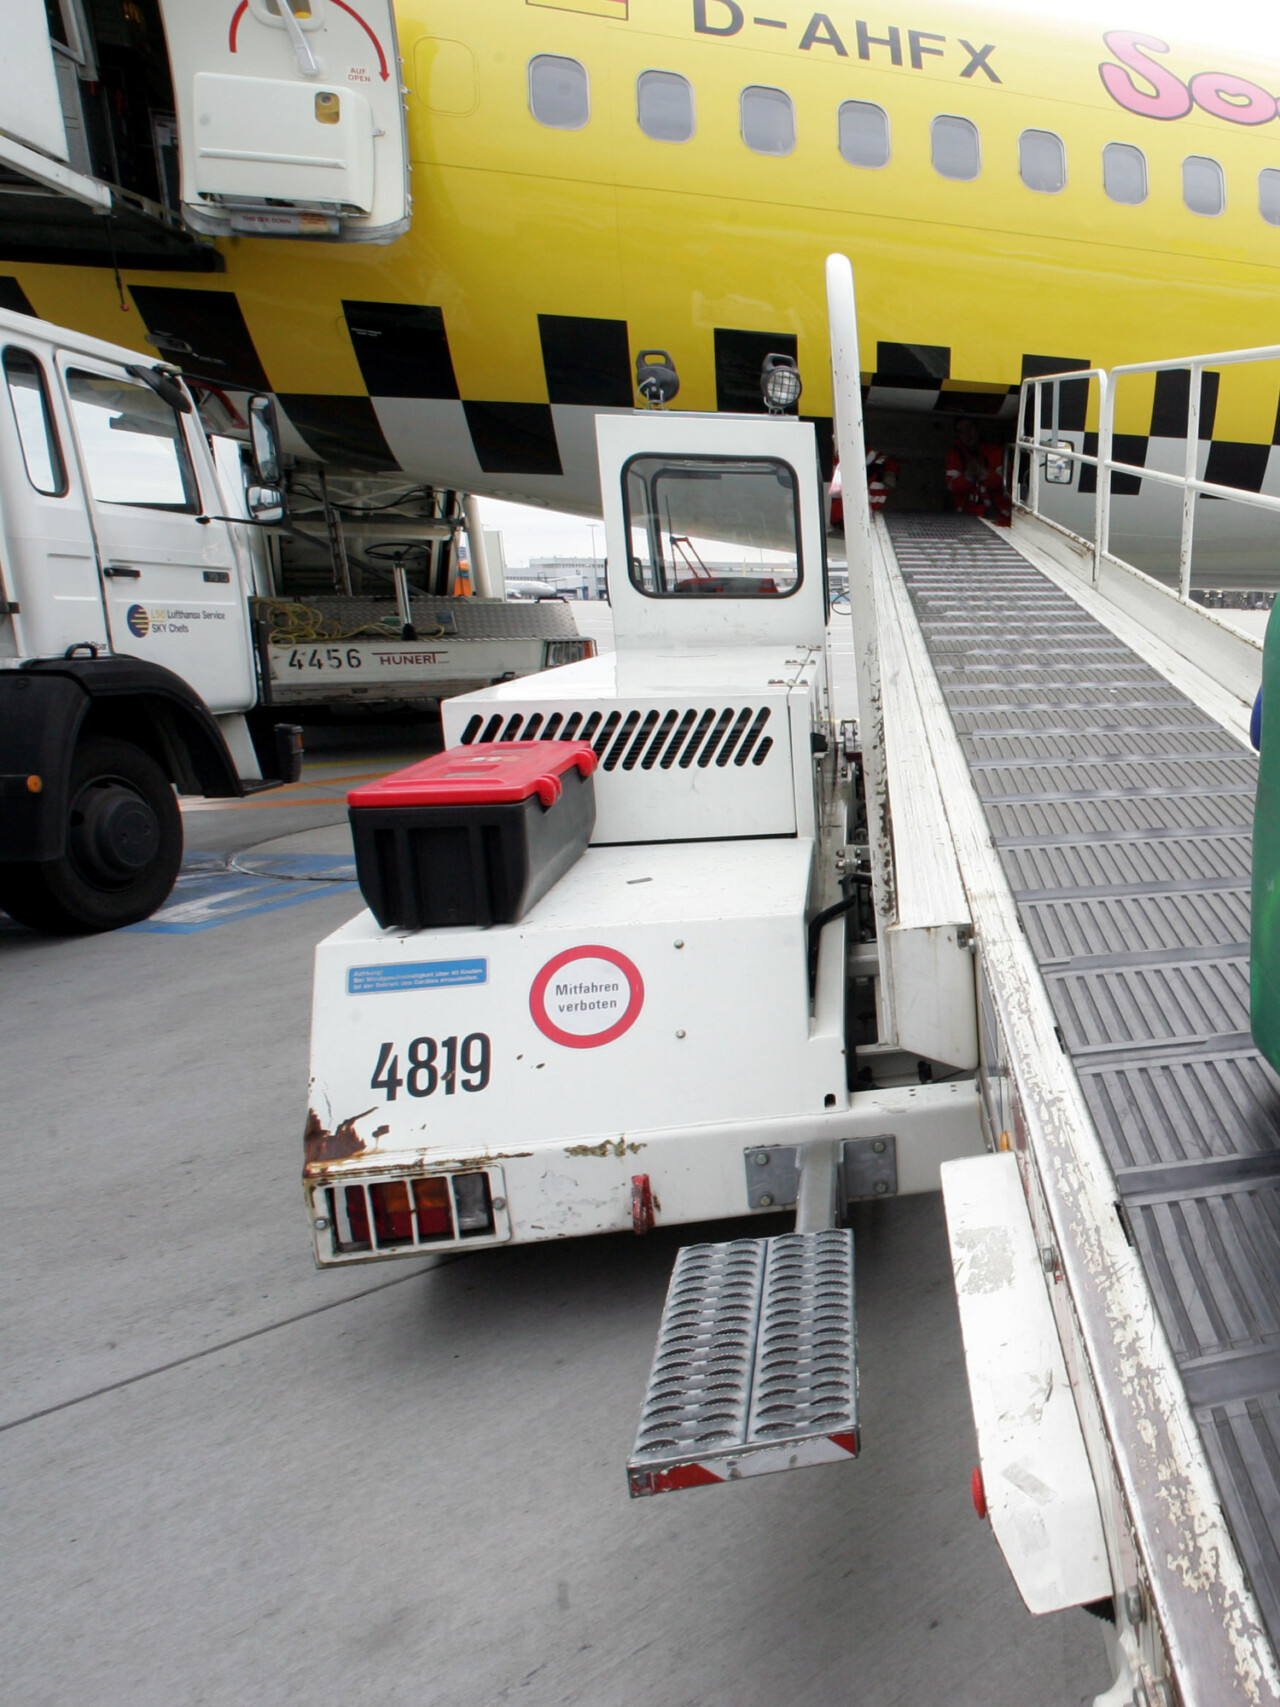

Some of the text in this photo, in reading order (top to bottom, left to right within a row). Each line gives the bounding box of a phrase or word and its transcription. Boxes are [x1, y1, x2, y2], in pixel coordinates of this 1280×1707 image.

[692, 0, 1004, 85] D-AHFX
[350, 67, 367, 75] AUF
[347, 74, 371, 83] OPEN
[167, 609, 201, 620] Lufthansa
[202, 610, 226, 620] Service
[151, 623, 189, 633] SKY Chefs
[288, 648, 362, 670] 4456
[379, 651, 438, 665] HUNERT
[555, 982, 619, 996] Mitfahren
[558, 999, 617, 1012] verboten
[370, 1032, 491, 1101] 4819
